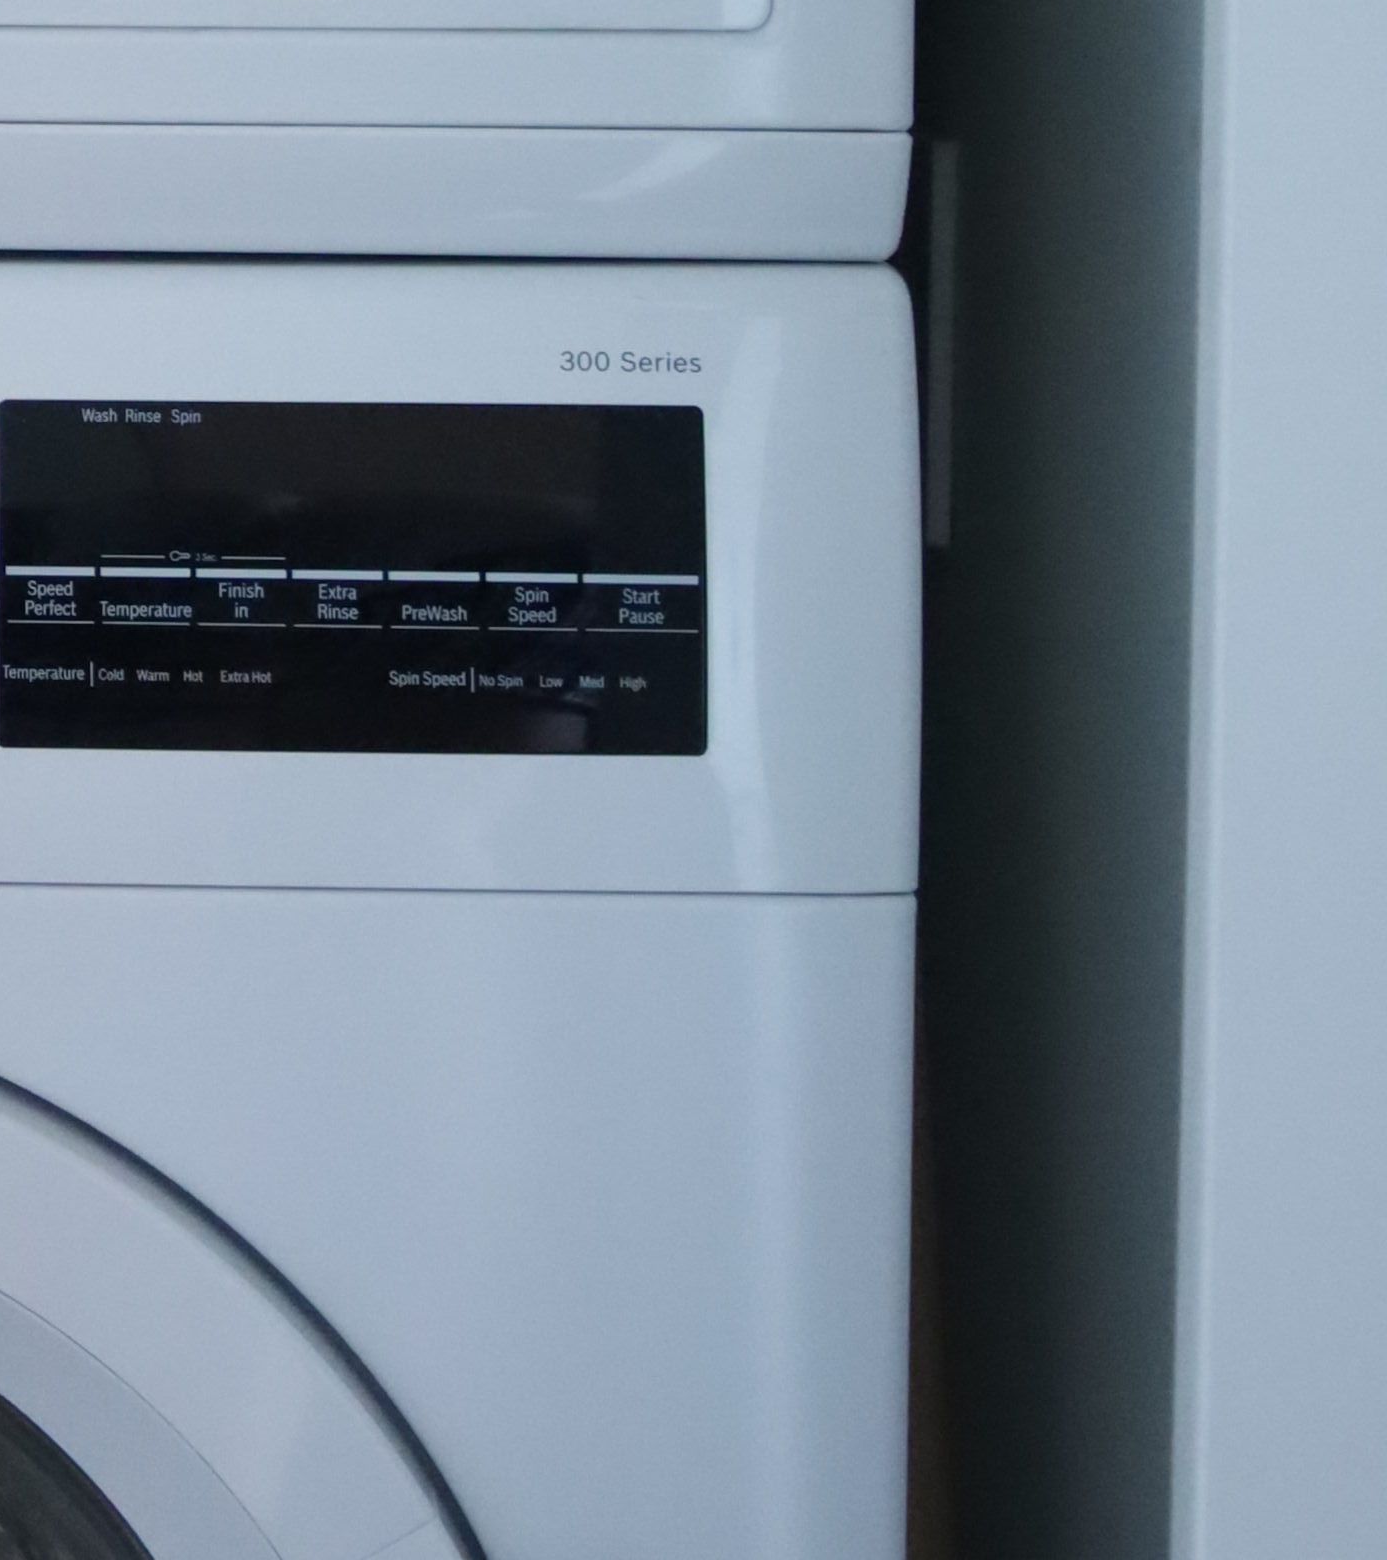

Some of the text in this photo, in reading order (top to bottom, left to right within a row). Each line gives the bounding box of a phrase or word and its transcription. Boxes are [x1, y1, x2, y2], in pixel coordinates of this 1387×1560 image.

[559, 350, 702, 374] 300 Series
[81, 407, 202, 427] Wash Rinse Spin
[27, 579, 74, 598] Speed
[218, 582, 265, 599] Finish
[318, 583, 357, 601] Extra
[514, 586, 549, 606] Spin
[622, 587, 661, 605] Start
[24, 599, 77, 617] Perfect
[99, 600, 193, 621] Temperature
[234, 601, 249, 619] in
[317, 603, 359, 620] Rinse
[401, 604, 468, 622] PreWash
[508, 605, 557, 625] Speed
[618, 607, 665, 625] Pause
[2, 664, 85, 683] Temperature
[97, 667, 272, 684] Cold Warm Hot Extra Hot
[389, 670, 467, 689] Spin Speed
[478, 674, 647, 693] No Spin Low Med High
